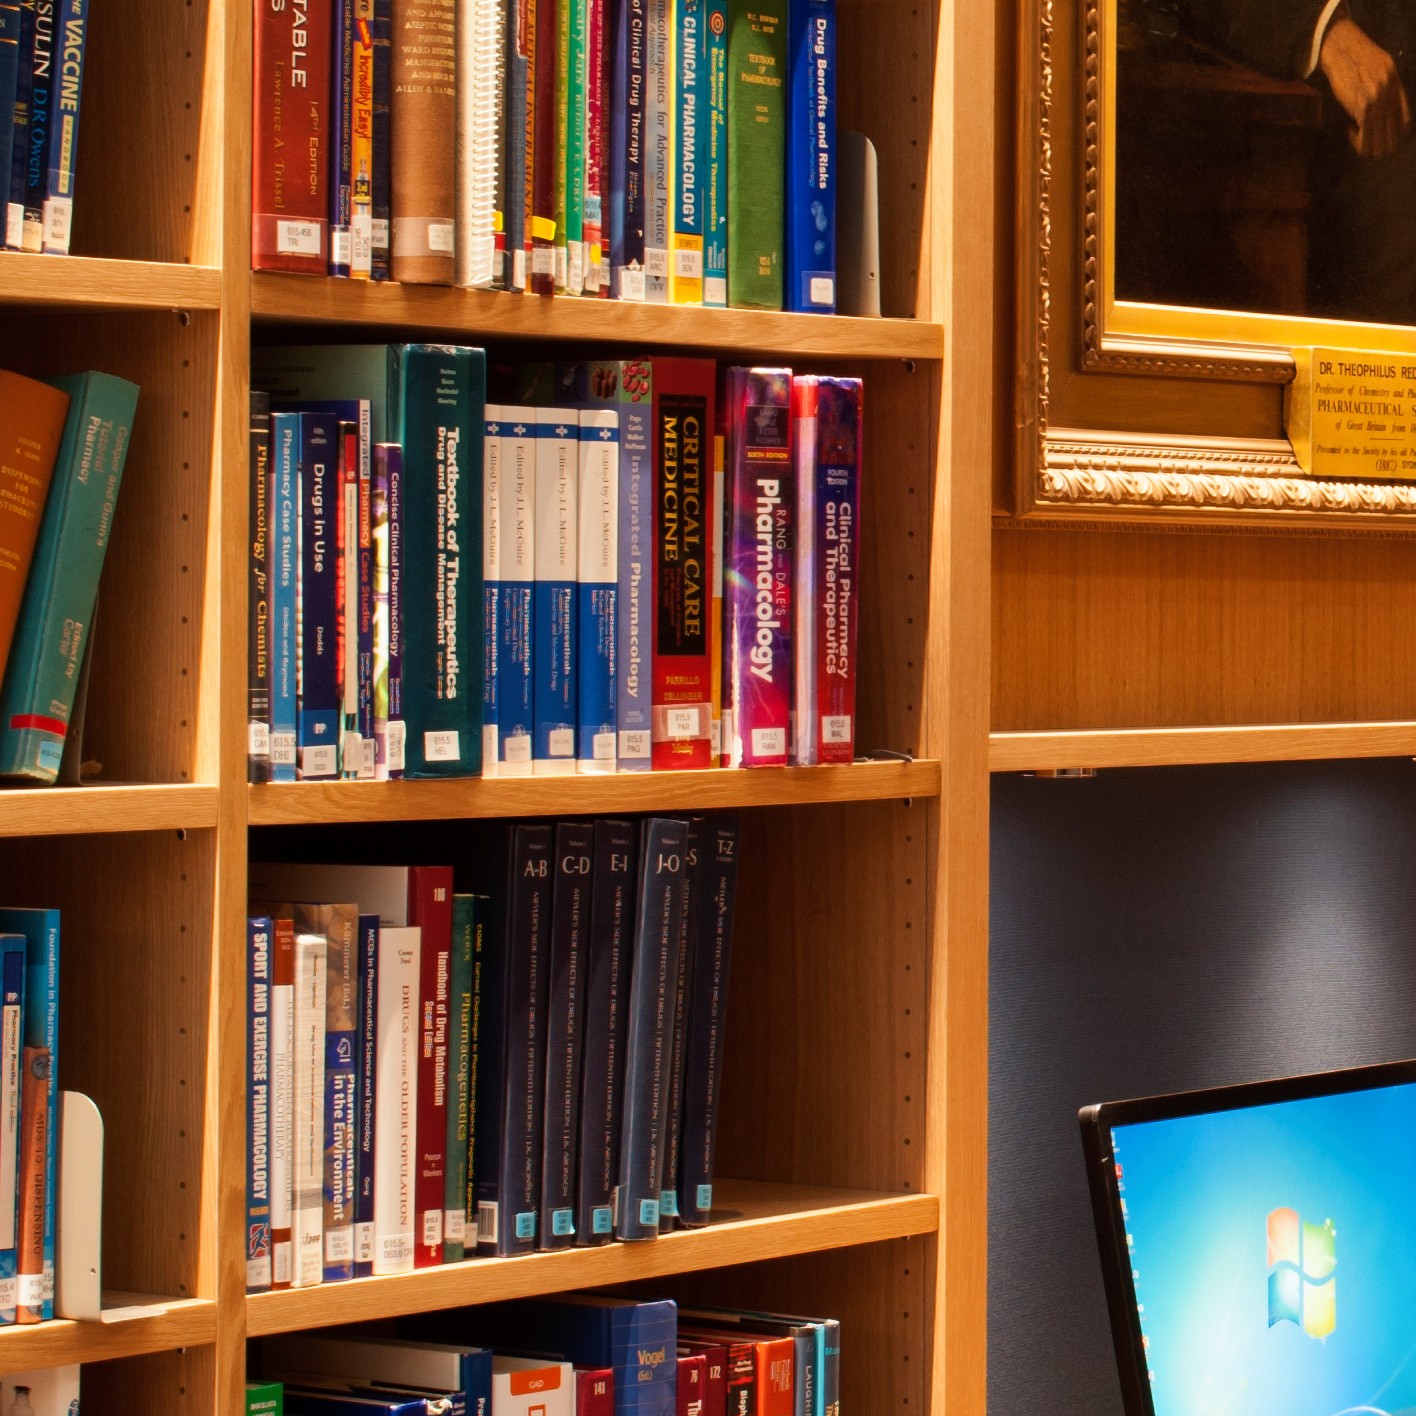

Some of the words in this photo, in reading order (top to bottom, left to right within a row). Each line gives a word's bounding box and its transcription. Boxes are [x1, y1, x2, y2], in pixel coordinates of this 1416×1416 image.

[631, 17, 643, 69] Clinical
[682, 17, 697, 89] CLINICAL
[814, 19, 827, 55] Drug
[60, 19, 84, 112] VACCINE
[355, 54, 372, 107] Incredibly
[816, 60, 828, 117] Benefits
[273, 60, 285, 133] Lawrence
[629, 75, 642, 106] Drug
[354, 109, 372, 139] Easy!
[628, 112, 642, 164] Therapy
[818, 121, 828, 148] and
[29, 128, 45, 188] Owens
[309, 137, 320, 195] EDITION
[682, 93, 697, 226] PHARMACOLOGY
[818, 153, 829, 189] Risks
[273, 161, 286, 209] Trissel
[1315, 382, 1344, 395] Professor
[1347, 384, 1356, 396] of
[1359, 386, 1390, 399] Chemistry
[1393, 388, 1404, 399] and
[1319, 361, 1334, 375] DR.
[1338, 362, 1397, 380] THEOPHILUS
[1317, 398, 1404, 417] PHARMACEUTICAL
[1335, 419, 1343, 431] of
[1347, 420, 1363, 431] Great
[1366, 421, 1387, 432] Britain
[1391, 422, 1406, 434] from
[282, 430, 293, 495] Pharmacy
[360, 409, 370, 477] Integrated
[435, 427, 447, 459] Drug
[311, 463, 326, 515] Drugs
[391, 472, 400, 519] Concise
[437, 463, 447, 488] and
[447, 427, 460, 527] Textbook
[664, 415, 679, 561] MEDICINE
[682, 416, 700, 552] CRITICAL
[253, 445, 267, 563] Pharmacology
[283, 500, 293, 533] Case
[314, 521, 326, 536] in
[360, 483, 371, 547] Pharmacy
[437, 491, 447, 550] Disease
[630, 456, 642, 558] Integrated
[825, 501, 837, 540] and
[391, 519, 400, 567] Clinical
[447, 531, 460, 551] of
[775, 509, 787, 550] RANG
[839, 502, 852, 571] Clinical
[254, 568, 266, 593] for
[281, 534, 292, 587] Studies
[314, 541, 326, 573] Use
[360, 552, 370, 582] Case
[751, 479, 781, 684] Pharmacology
[360, 584, 370, 633] Studies
[389, 571, 400, 657] Pharmacology
[435, 554, 447, 645] Management
[683, 558, 700, 636] CARE
[774, 572, 787, 616] DALE'S
[825, 546, 838, 674] Therapeutics
[257, 601, 267, 678] Chemists
[316, 627, 324, 655] Dodds
[445, 556, 460, 699] Therapeutics
[627, 562, 643, 698] Pharmacology
[838, 578, 851, 679] Pharmacy
[524, 860, 548, 877] A-B
[562, 856, 590, 875] C-D
[611, 854, 628, 872] E-I
[656, 853, 680, 874] J-O
[717, 840, 734, 855] T-Z
[253, 932, 268, 980] SPORT
[437, 951, 449, 1001] Handbook
[253, 984, 268, 1013] AND
[401, 984, 410, 1033] DRUGS
[436, 1005, 447, 1015] of
[253, 1017, 268, 1081] EXERCISE
[434, 1018, 447, 1043] Drug
[333, 1075, 346, 1090] in
[434, 1046, 447, 1106] Metabolism
[333, 1093, 346, 1119] the
[400, 1081, 409, 1129] OLDER
[252, 1083, 268, 1200] PHARMACOLOGY
[345, 1073, 356, 1199] Pharmaceuticals
[331, 1123, 347, 1221] Environment
[399, 1134, 408, 1226] POPULATION
[637, 1347, 666, 1369] Vogel
